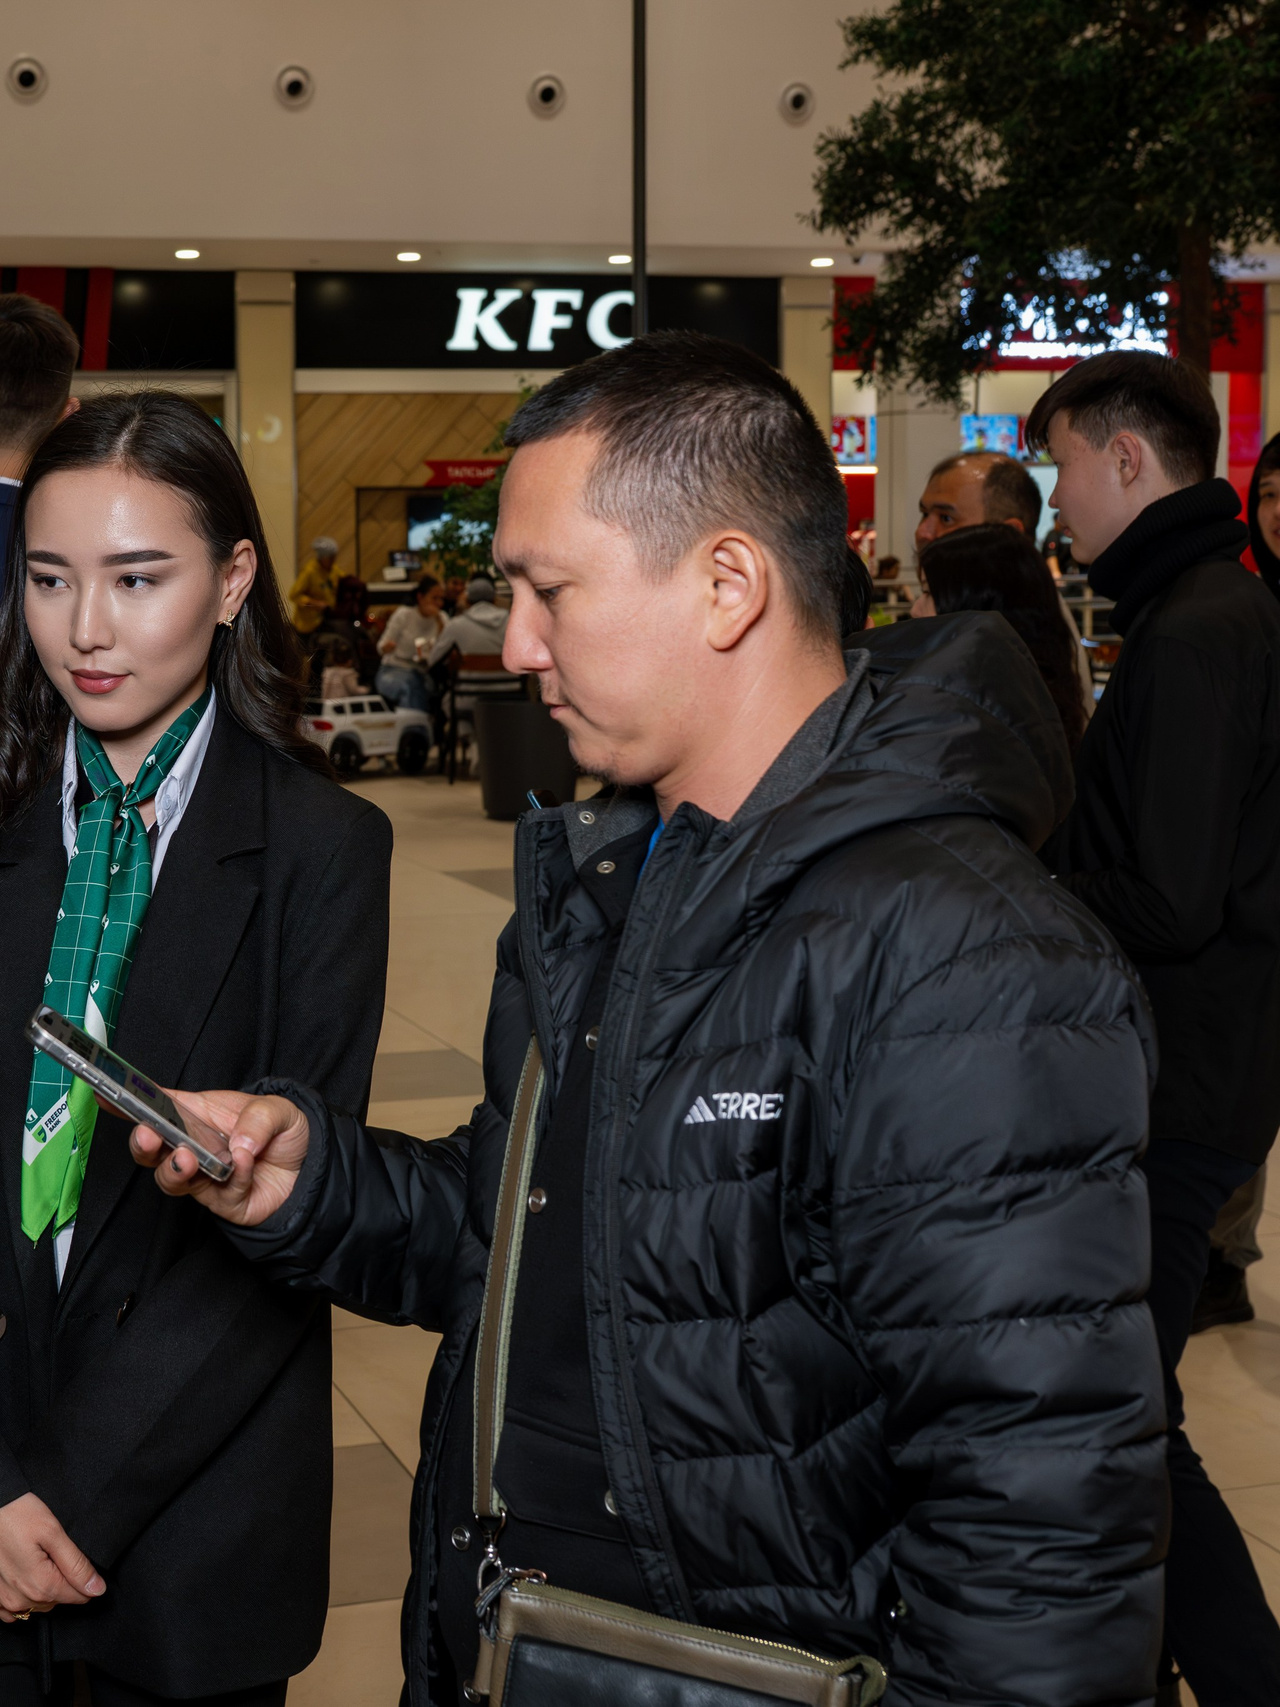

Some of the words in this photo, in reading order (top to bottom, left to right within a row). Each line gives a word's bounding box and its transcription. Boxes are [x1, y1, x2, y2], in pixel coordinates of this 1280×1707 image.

[446, 287, 635, 352] KFC
[447, 466, 496, 478] ТАПСЫР
[48, 1119, 61, 1133] BANK
